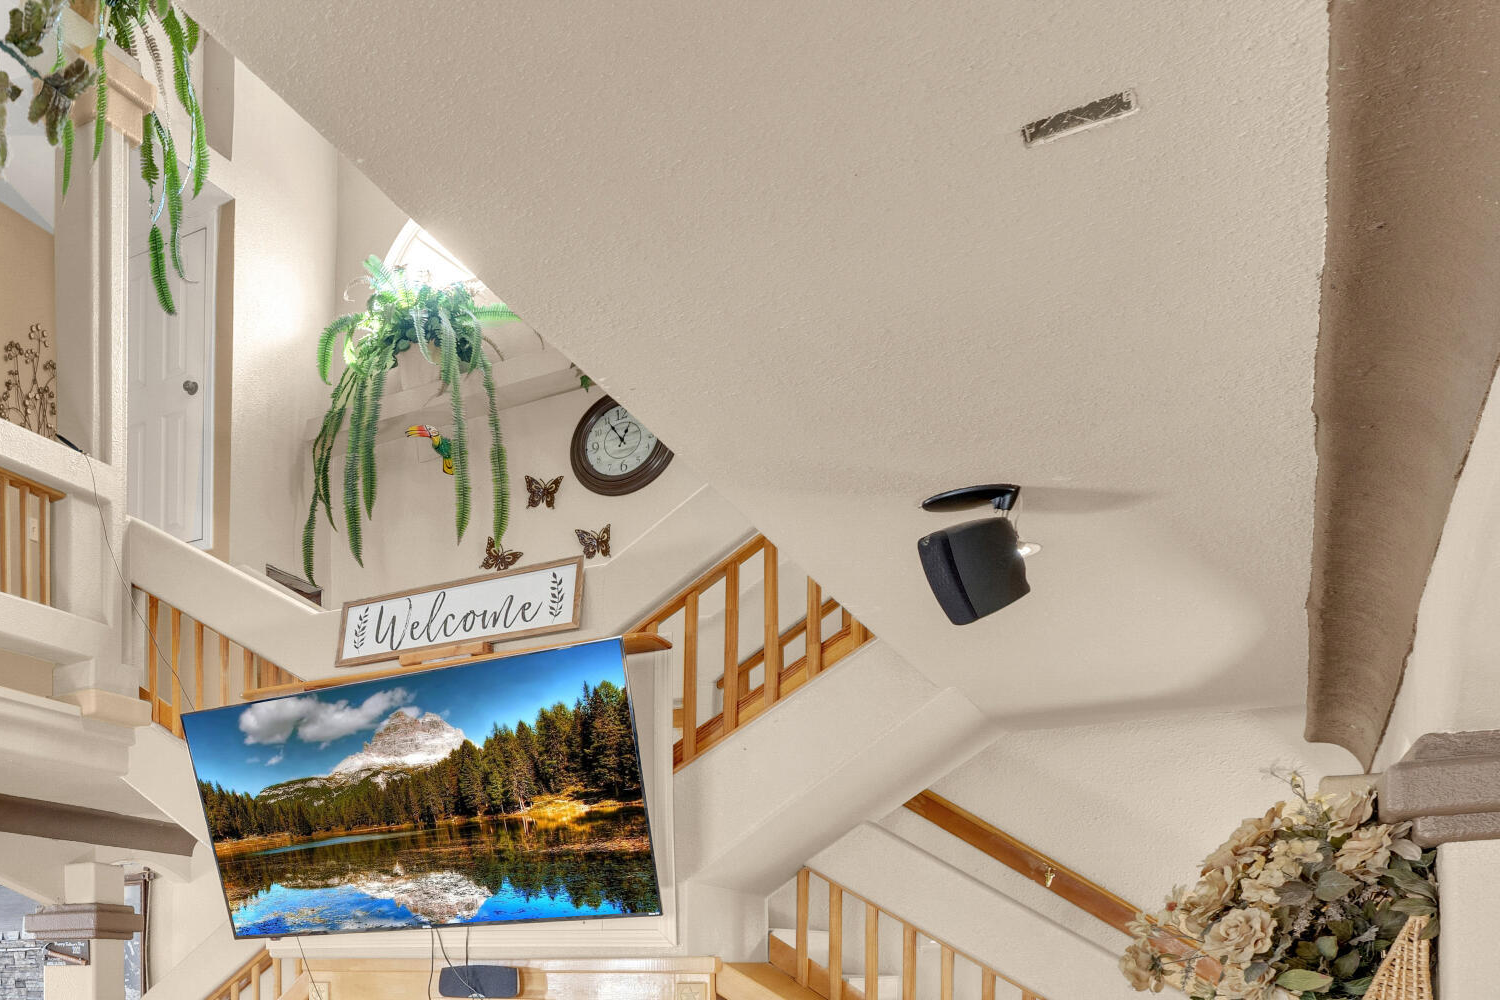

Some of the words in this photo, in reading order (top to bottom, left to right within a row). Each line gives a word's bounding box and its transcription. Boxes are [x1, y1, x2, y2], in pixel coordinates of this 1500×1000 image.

[592, 442, 600, 454] 9
[620, 460, 628, 472] 6
[375, 591, 543, 651] Welcome
